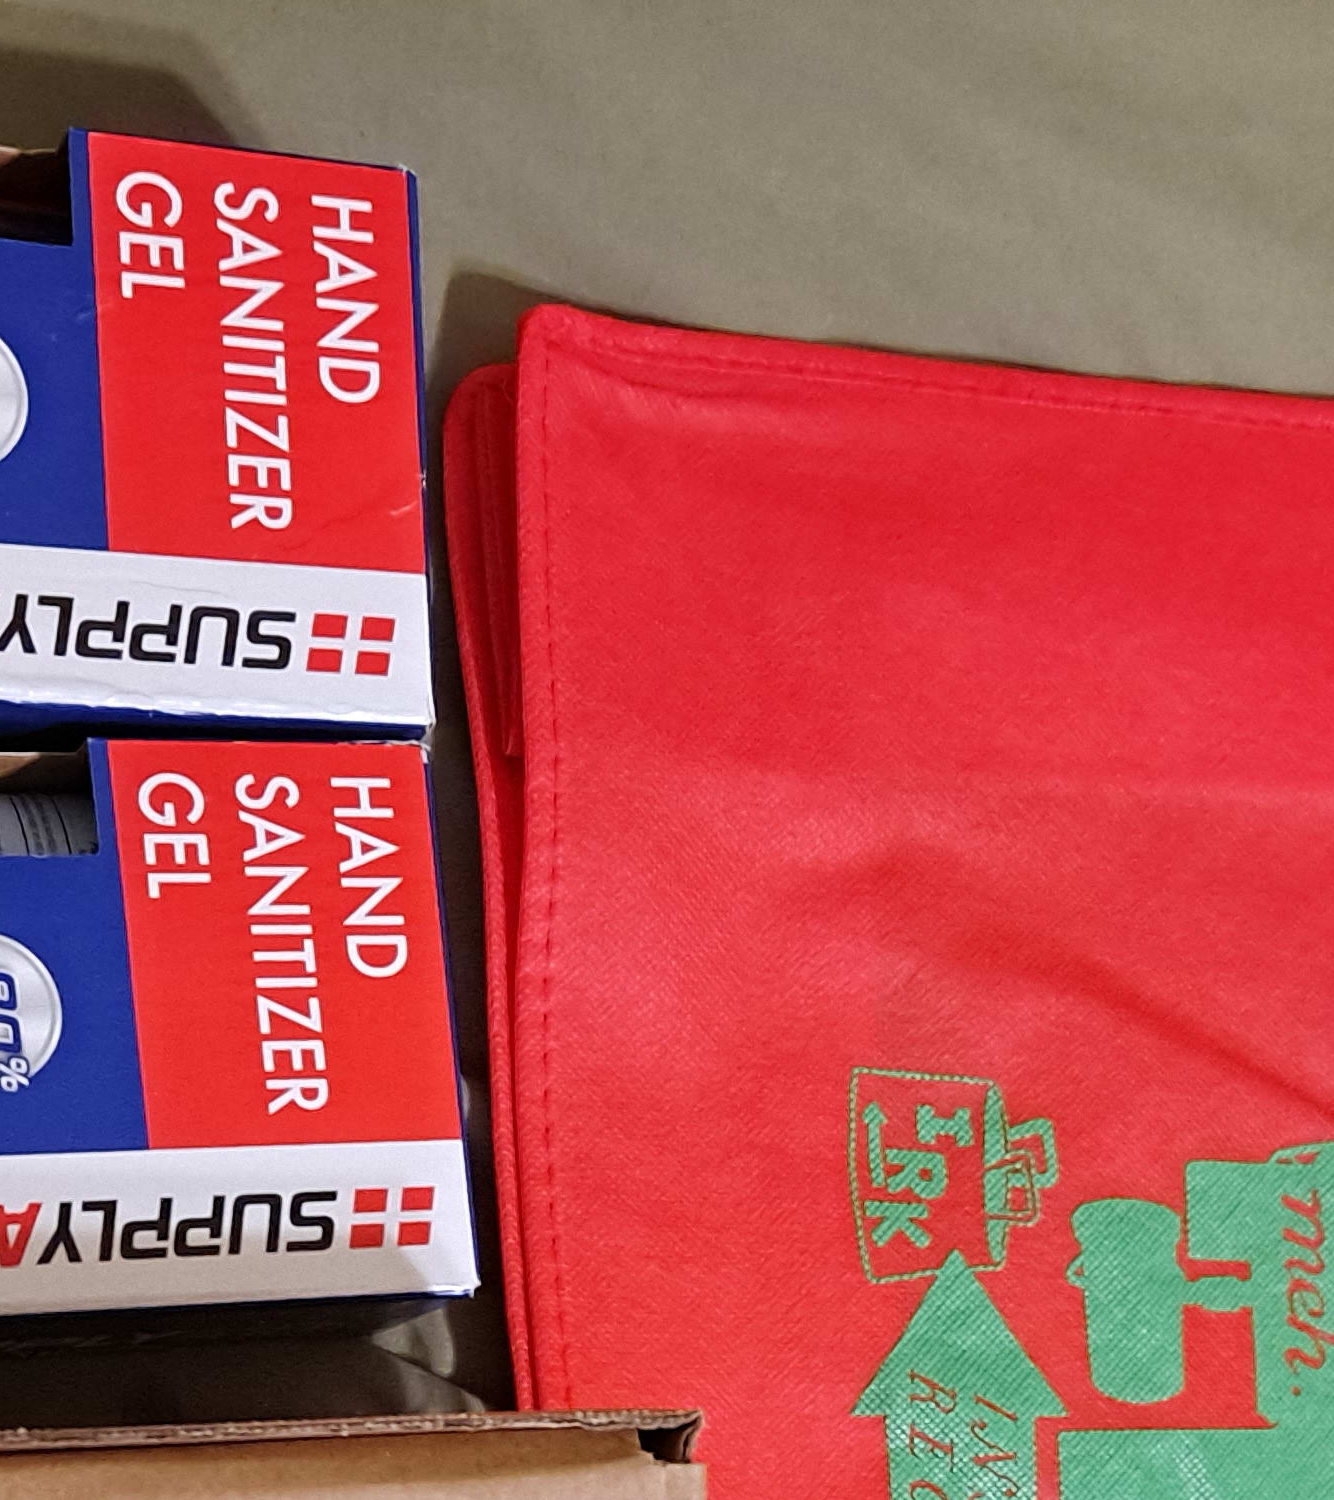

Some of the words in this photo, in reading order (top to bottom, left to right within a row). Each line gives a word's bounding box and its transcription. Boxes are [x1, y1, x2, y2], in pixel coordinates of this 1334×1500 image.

[114, 170, 186, 299] GEL
[309, 194, 381, 405] HAND
[212, 182, 294, 531] SANITIZER
[136, 771, 211, 899] GEL
[328, 776, 408, 979] HAND
[233, 772, 329, 1115] SANITIZER
[862, 1103, 973, 1251] IRK
